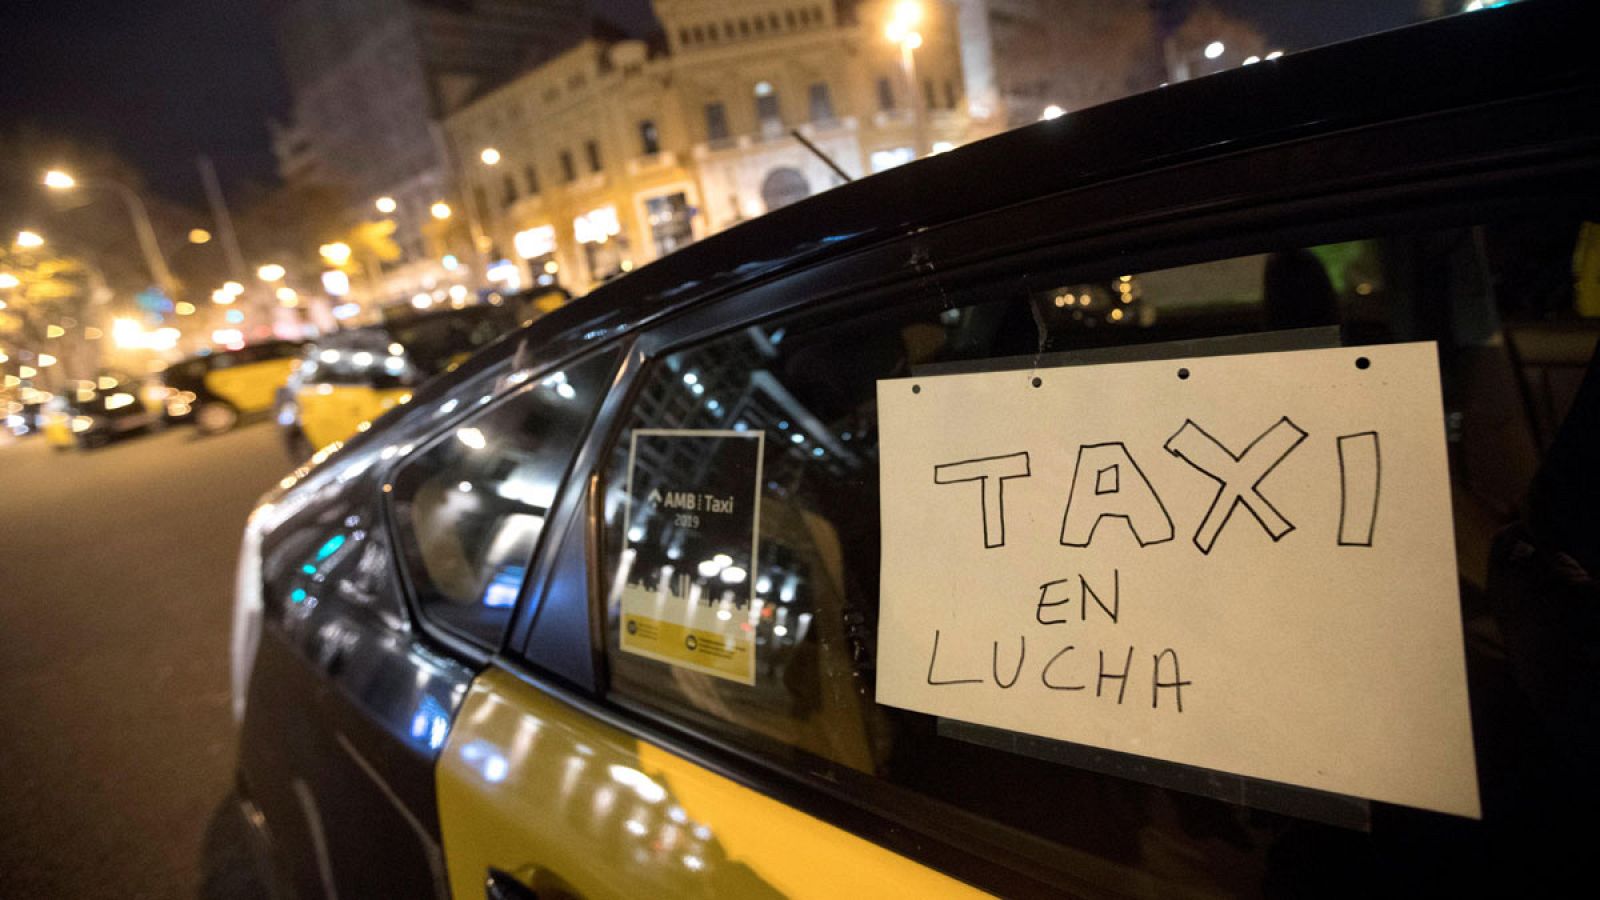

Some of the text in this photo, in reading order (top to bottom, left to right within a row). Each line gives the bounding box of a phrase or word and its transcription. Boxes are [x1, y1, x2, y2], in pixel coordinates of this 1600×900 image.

[664, 491, 734, 514] AMB Taxi
[934, 416, 1381, 554] TAXI
[674, 514, 700, 528] 2019
[1036, 569, 1119, 624] EN
[927, 630, 1192, 713] LUCHA
